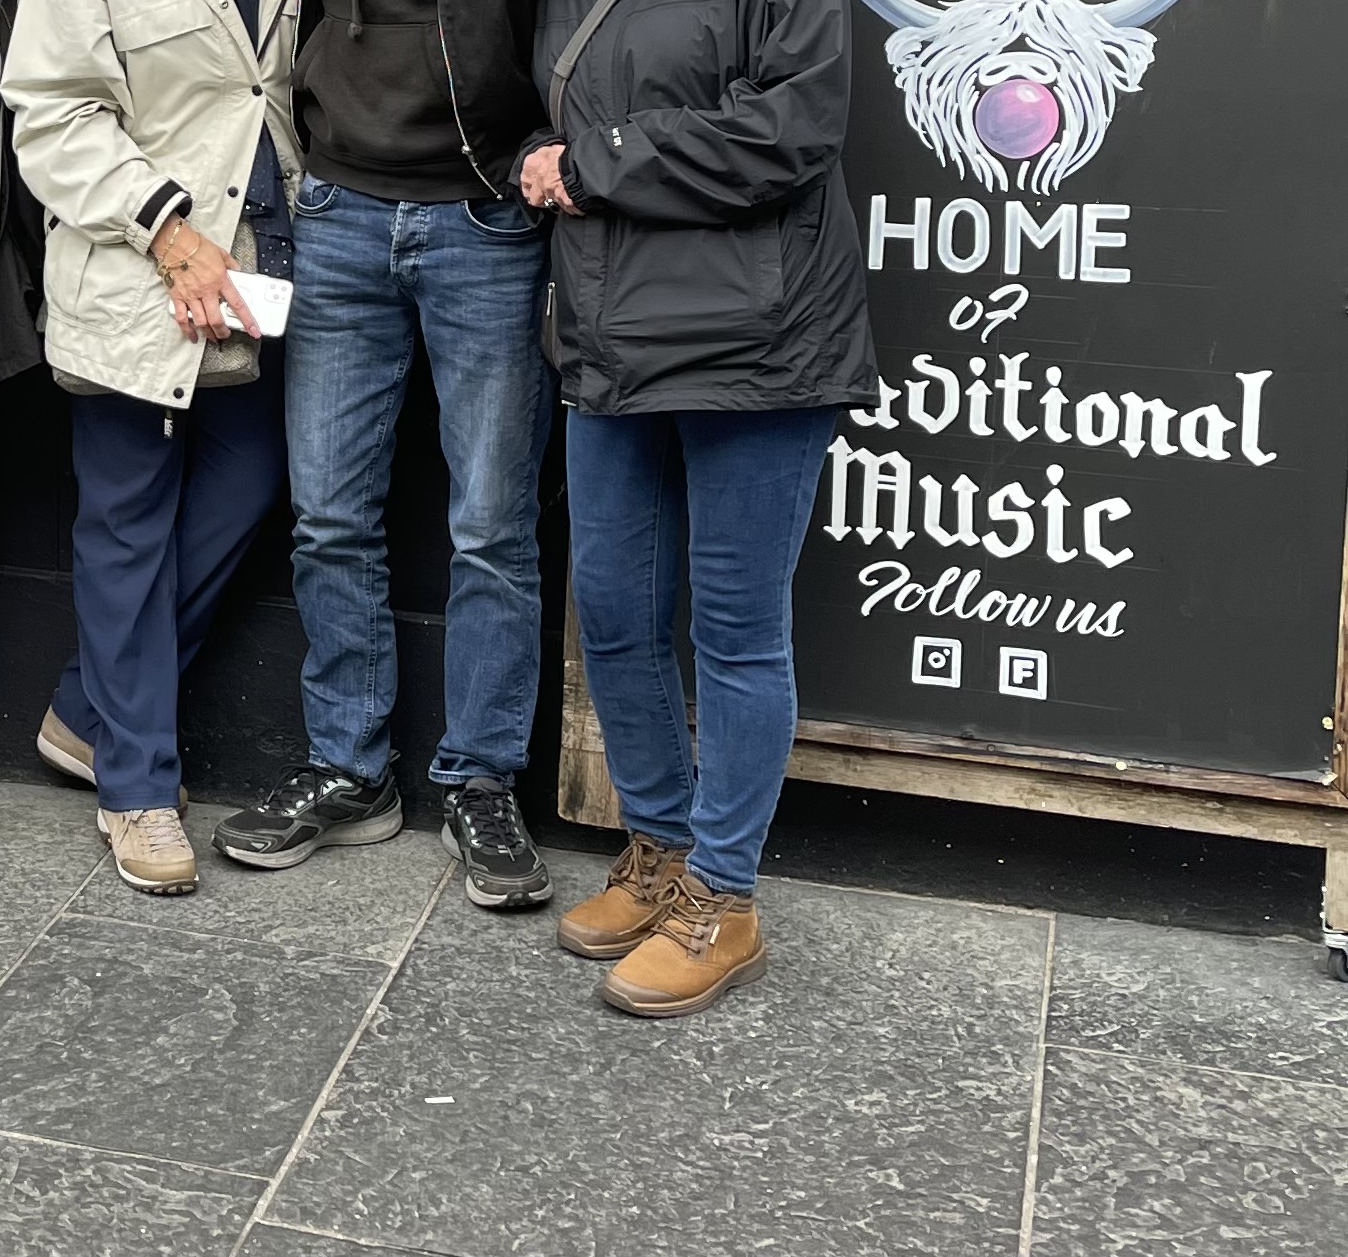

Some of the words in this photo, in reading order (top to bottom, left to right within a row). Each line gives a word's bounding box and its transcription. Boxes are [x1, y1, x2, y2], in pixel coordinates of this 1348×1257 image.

[868, 194, 1131, 282] HOME
[849, 352, 1278, 466] aditional
[823, 435, 1134, 568] Music
[858, 561, 1052, 627] Follow
[1055, 601, 1126, 637] us
